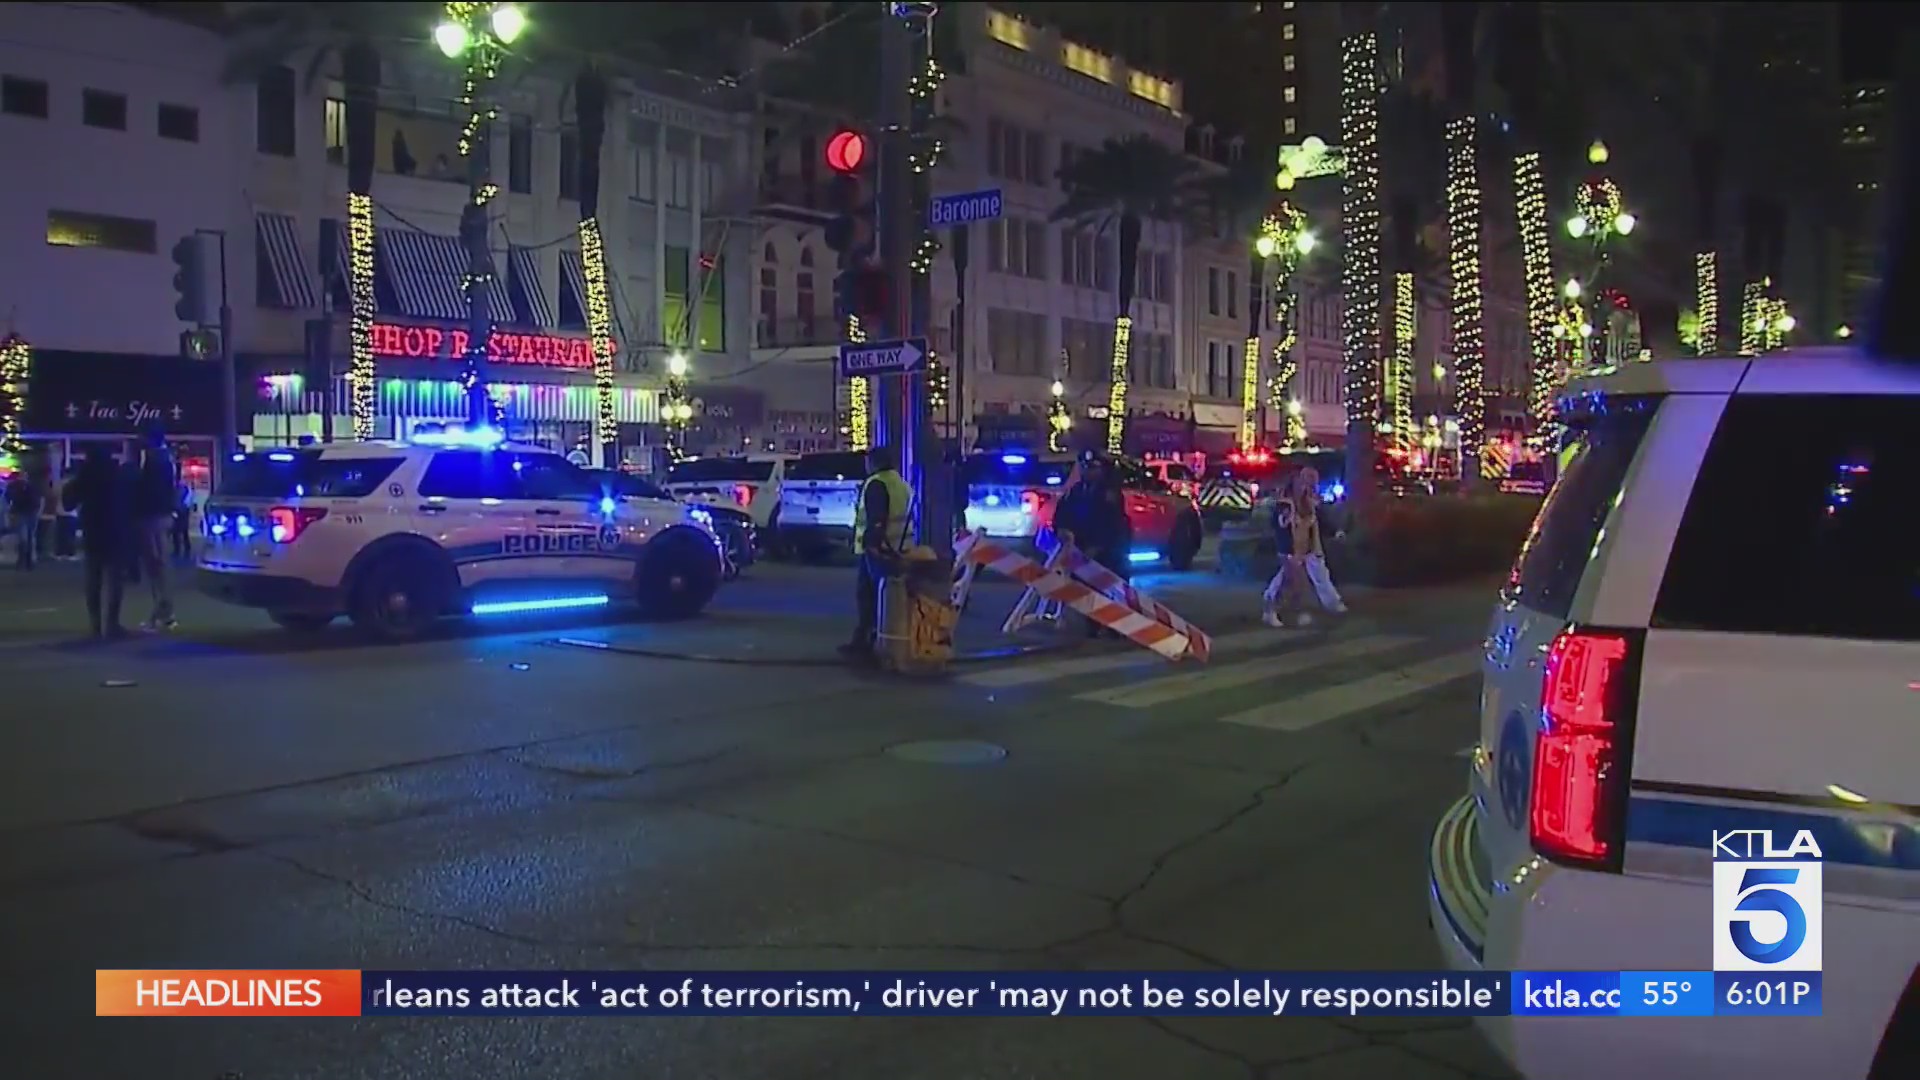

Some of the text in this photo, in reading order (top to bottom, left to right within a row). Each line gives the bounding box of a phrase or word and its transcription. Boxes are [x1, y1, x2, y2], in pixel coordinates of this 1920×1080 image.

[931, 196, 1000, 223] Baronne
[850, 350, 902, 367] ONE WAY
[126, 401, 161, 426] Spa
[503, 533, 597, 553] POLICE
